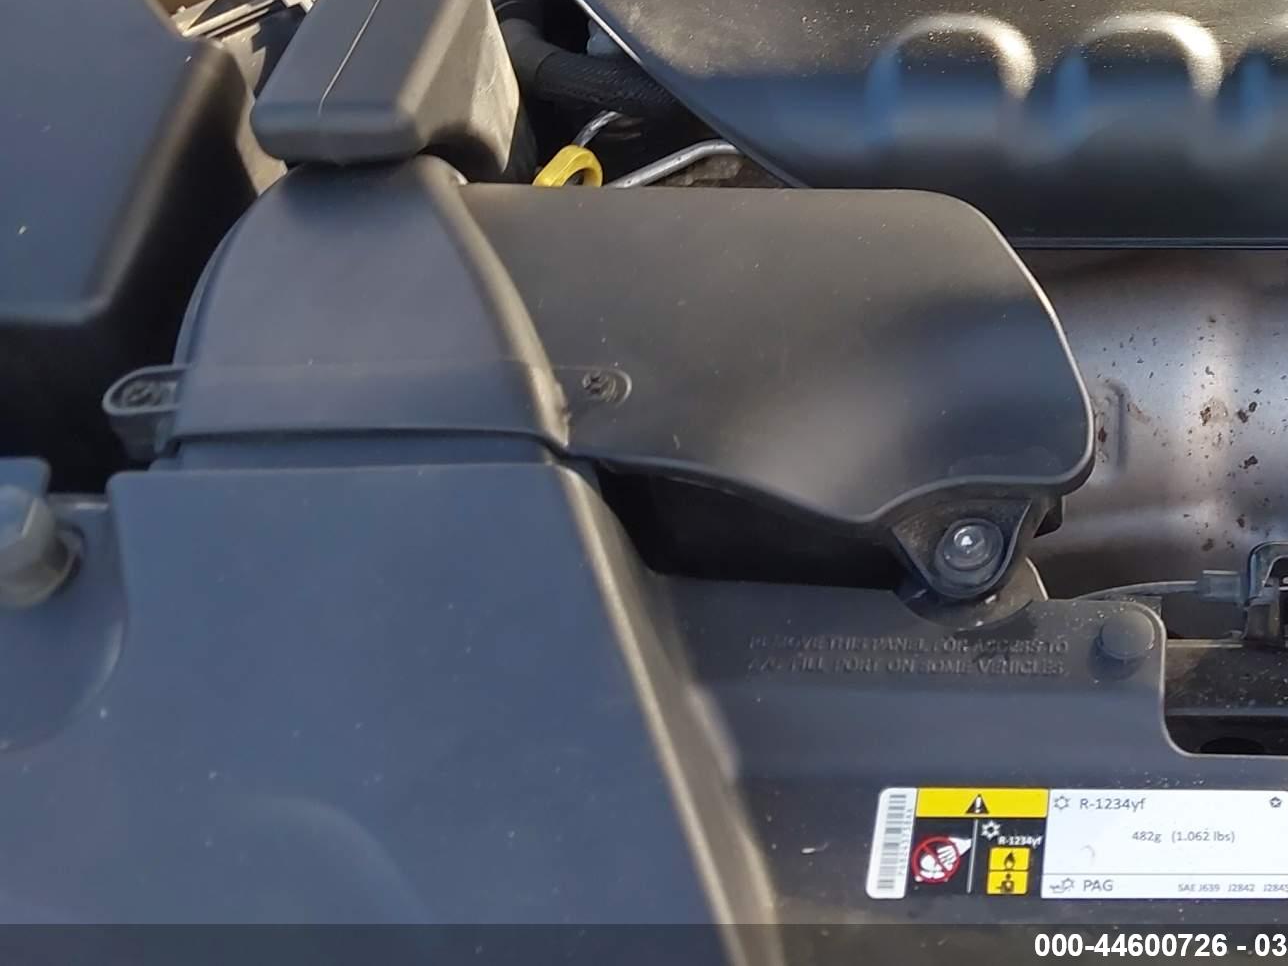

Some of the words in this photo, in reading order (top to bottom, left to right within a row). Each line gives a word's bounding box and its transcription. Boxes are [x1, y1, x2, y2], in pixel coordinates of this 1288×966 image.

[1079, 797, 1146, 813] R-1234yf
[998, 835, 1042, 849] R-1234yf
[1131, 831, 1162, 843] 482g
[1171, 830, 1210, 843] (1.062
[1213, 830, 1235, 843] lbs)
[1082, 879, 1114, 892] PAG
[1178, 883, 1195, 892] SAE
[1199, 883, 1221, 892] J639
[1228, 883, 1256, 893] J2842
